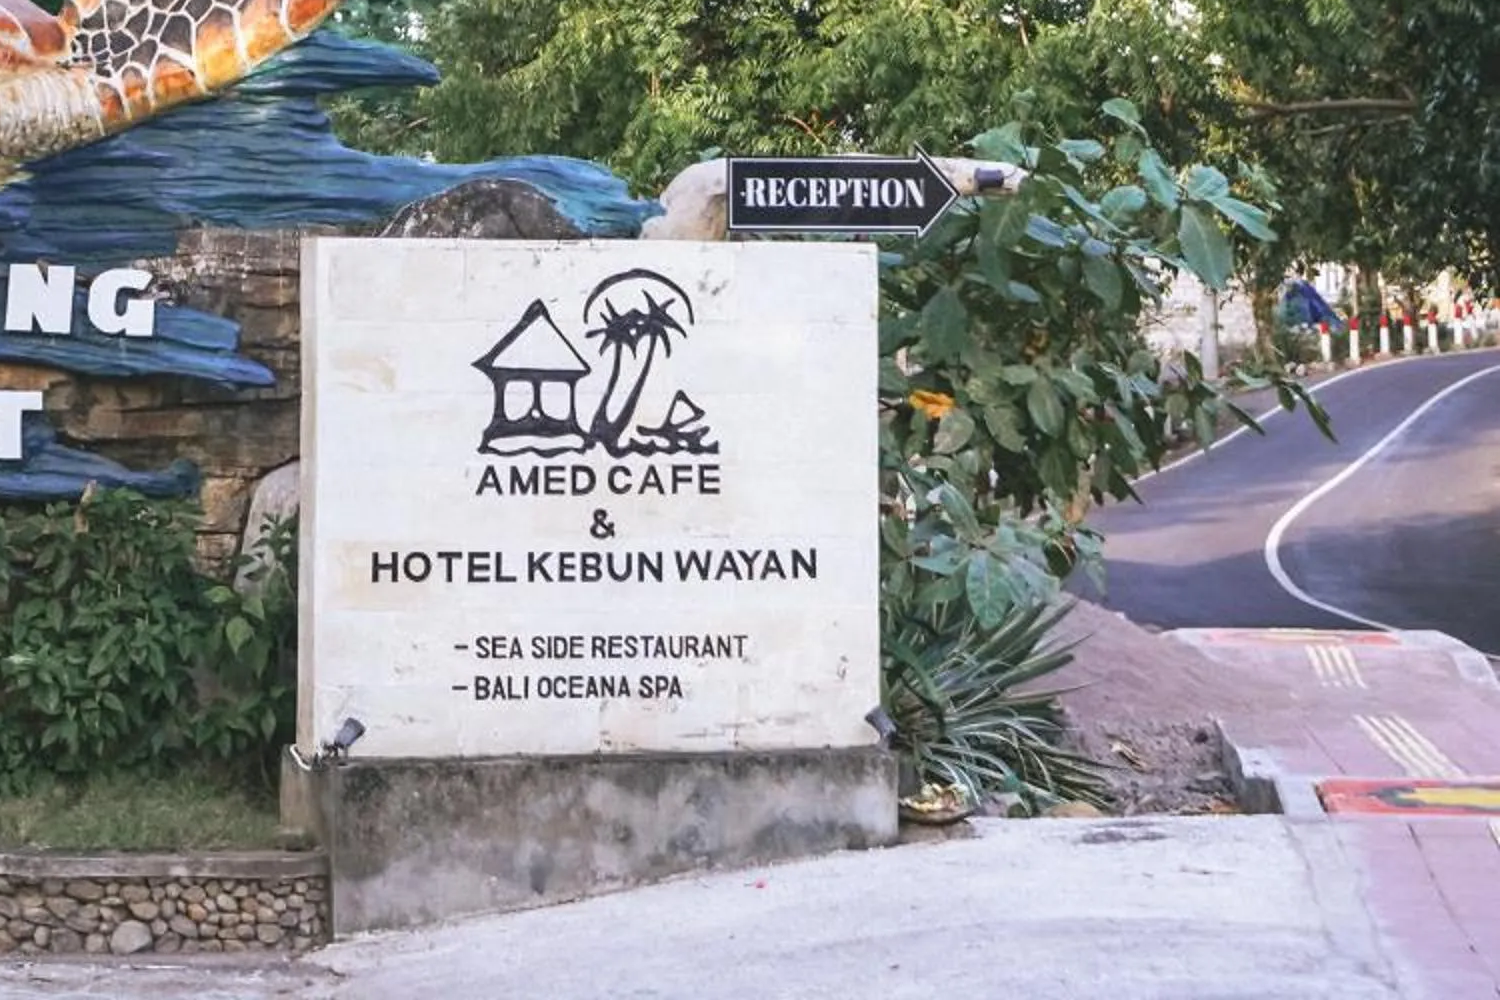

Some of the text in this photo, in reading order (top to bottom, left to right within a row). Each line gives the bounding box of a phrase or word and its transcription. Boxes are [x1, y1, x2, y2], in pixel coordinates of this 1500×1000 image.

[740, 177, 926, 208] RECEPTION
[474, 464, 721, 496] AMED CAFE
[588, 508, 615, 540] &
[370, 548, 817, 583] HOTEL KEBUN WAYAN
[475, 635, 524, 659] SEA
[531, 635, 585, 659] SIDE
[590, 634, 749, 660] RESTAURANT
[474, 674, 530, 701] BALI
[536, 674, 632, 700] OCEANA
[638, 674, 684, 699] SPA
